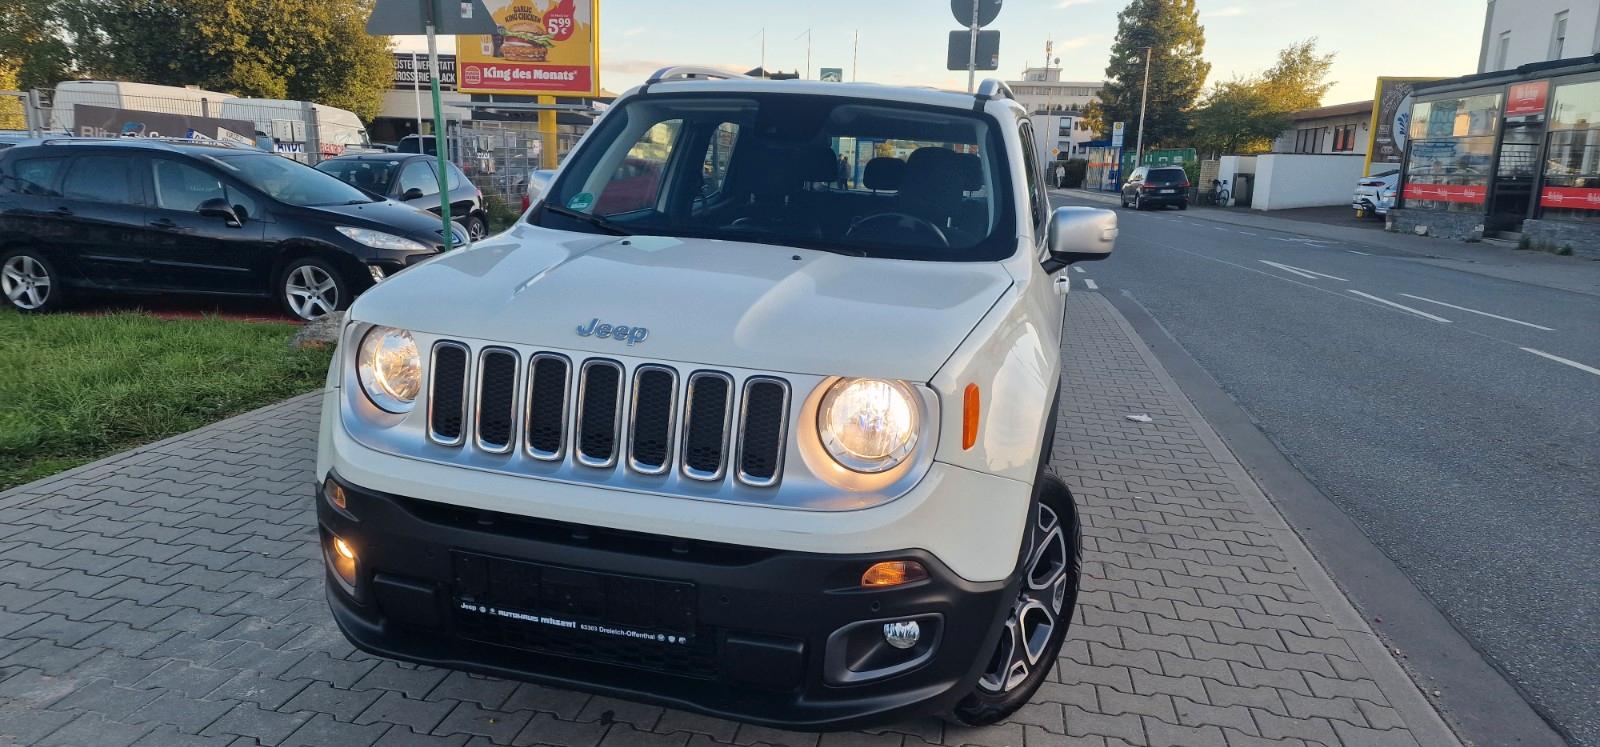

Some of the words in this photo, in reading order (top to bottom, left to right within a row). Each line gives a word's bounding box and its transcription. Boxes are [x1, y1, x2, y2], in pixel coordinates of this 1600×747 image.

[483, 66, 511, 81] King
[512, 69, 531, 79] des
[576, 318, 649, 346] Jeep
[461, 602, 477, 611] Jeep
